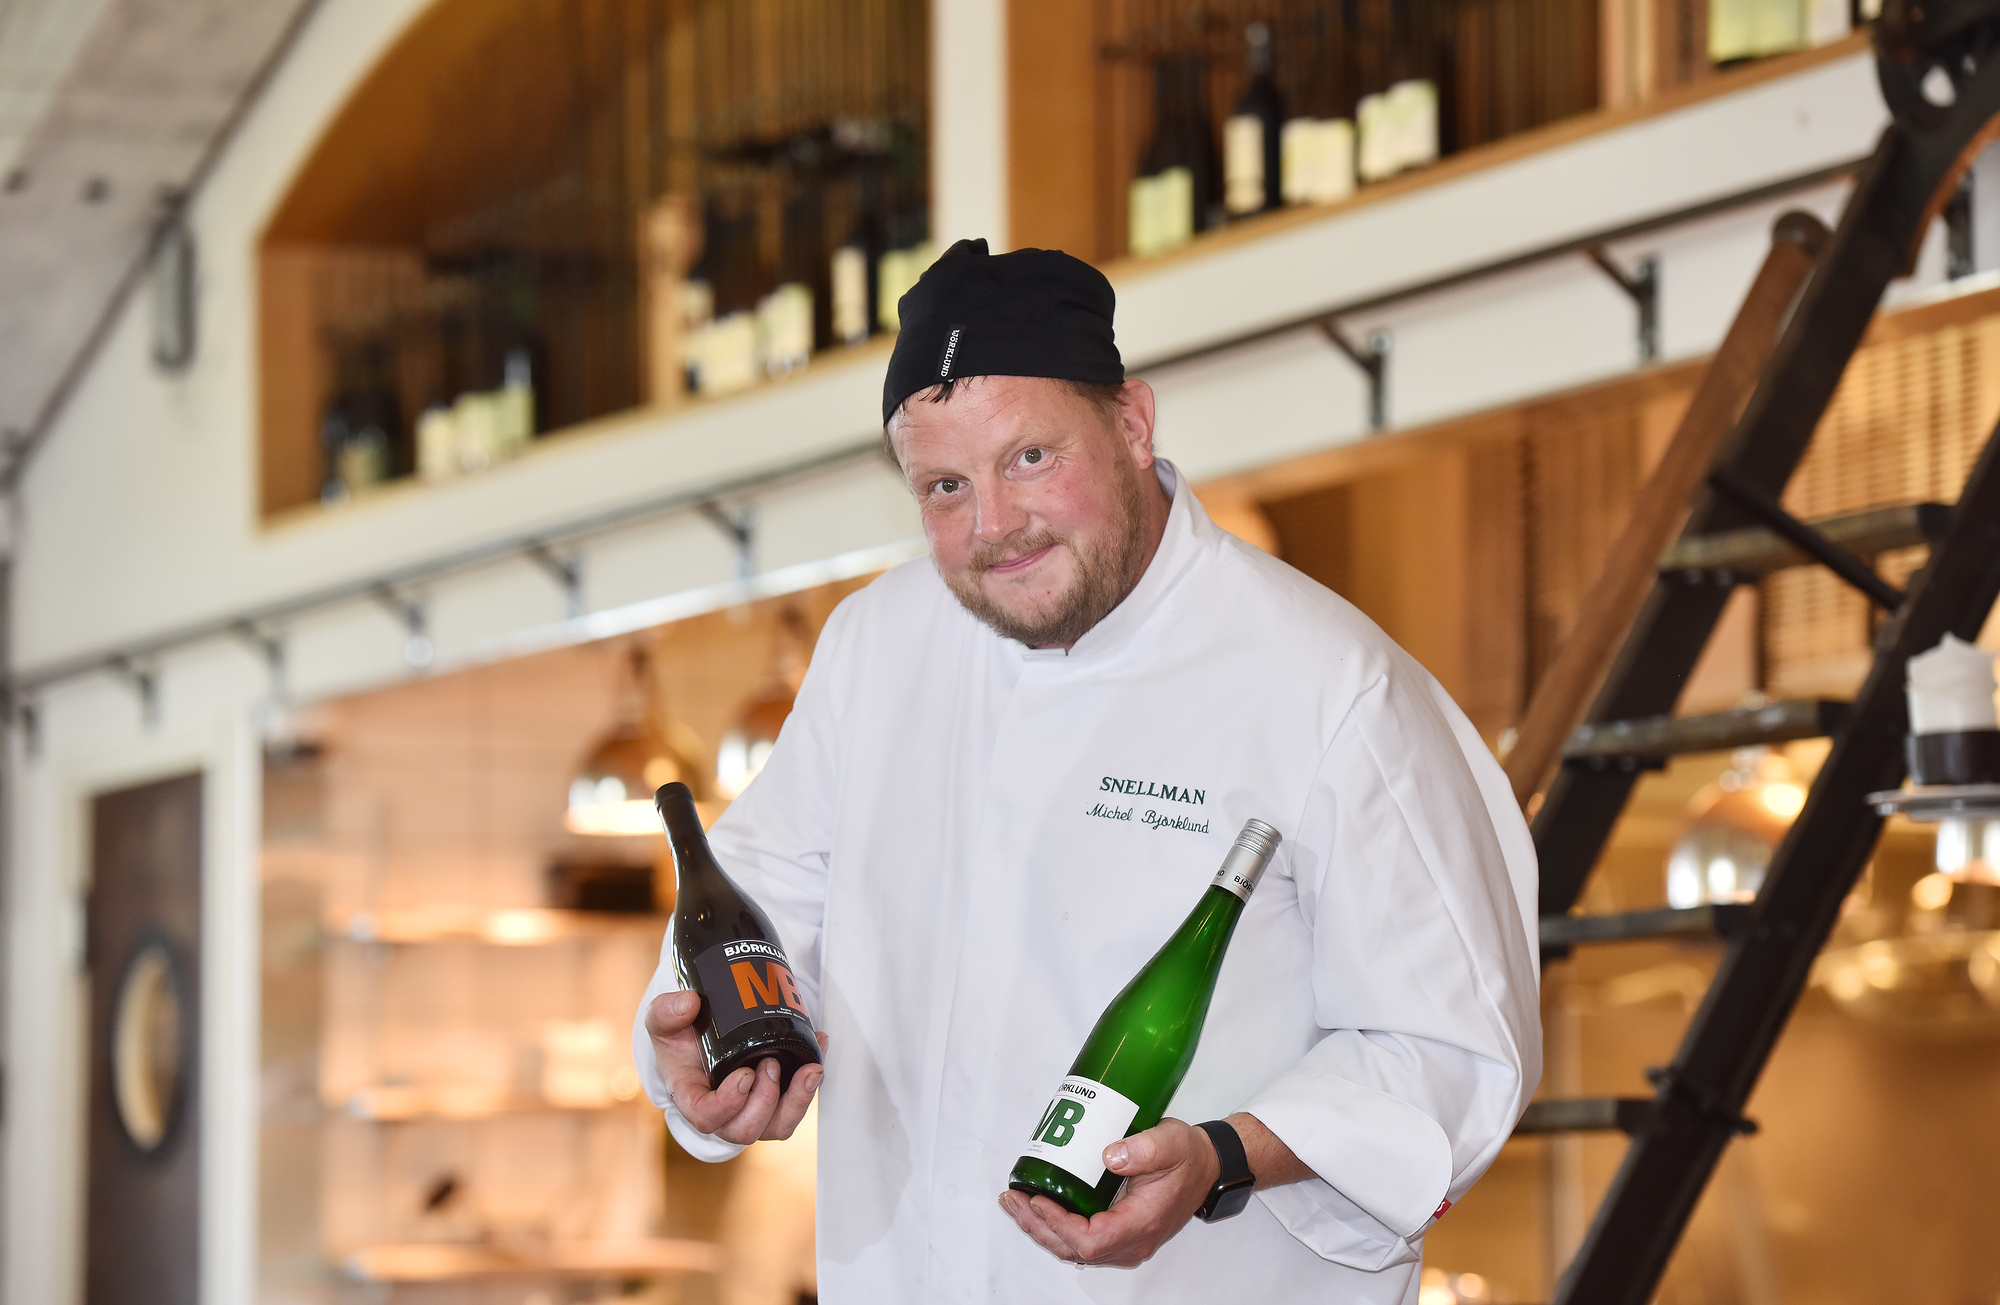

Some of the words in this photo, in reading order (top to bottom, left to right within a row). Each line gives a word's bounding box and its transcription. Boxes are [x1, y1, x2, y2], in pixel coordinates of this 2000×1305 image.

[1099, 776, 1206, 806] SNELLMAN
[1086, 803, 1133, 822] Michel
[1141, 809, 1210, 834] Björklund
[1233, 875, 1254, 893] BJÖR
